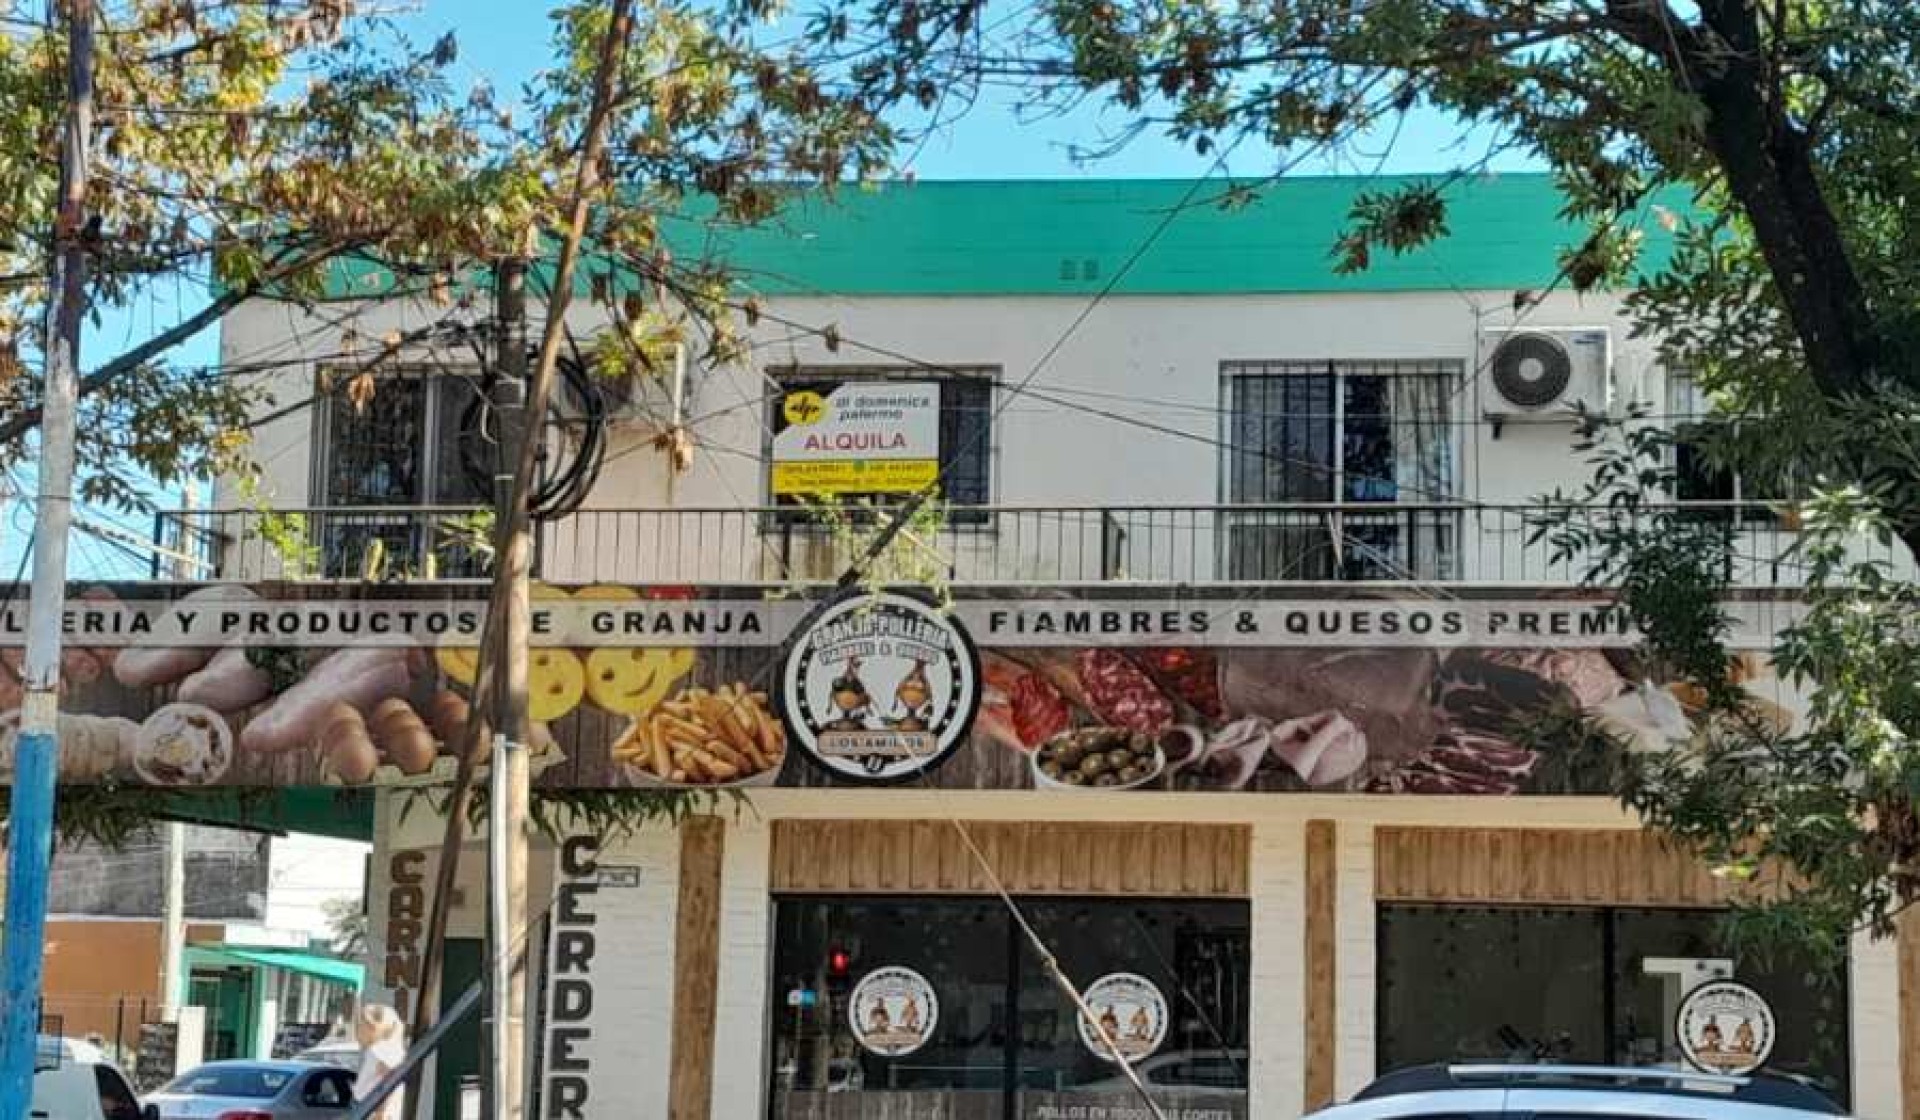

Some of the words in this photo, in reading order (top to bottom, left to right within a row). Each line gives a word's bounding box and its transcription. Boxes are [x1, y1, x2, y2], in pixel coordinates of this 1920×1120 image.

[804, 432, 907, 450] ALQUILA
[5, 610, 152, 634] LERIA
[175, 611, 197, 633] Y
[221, 610, 479, 634] PRODUCTOS
[591, 611, 763, 634] GRANJA
[988, 611, 1210, 633] FIAMBRES
[1235, 611, 1258, 633] &
[1285, 610, 1463, 635] QUESOS
